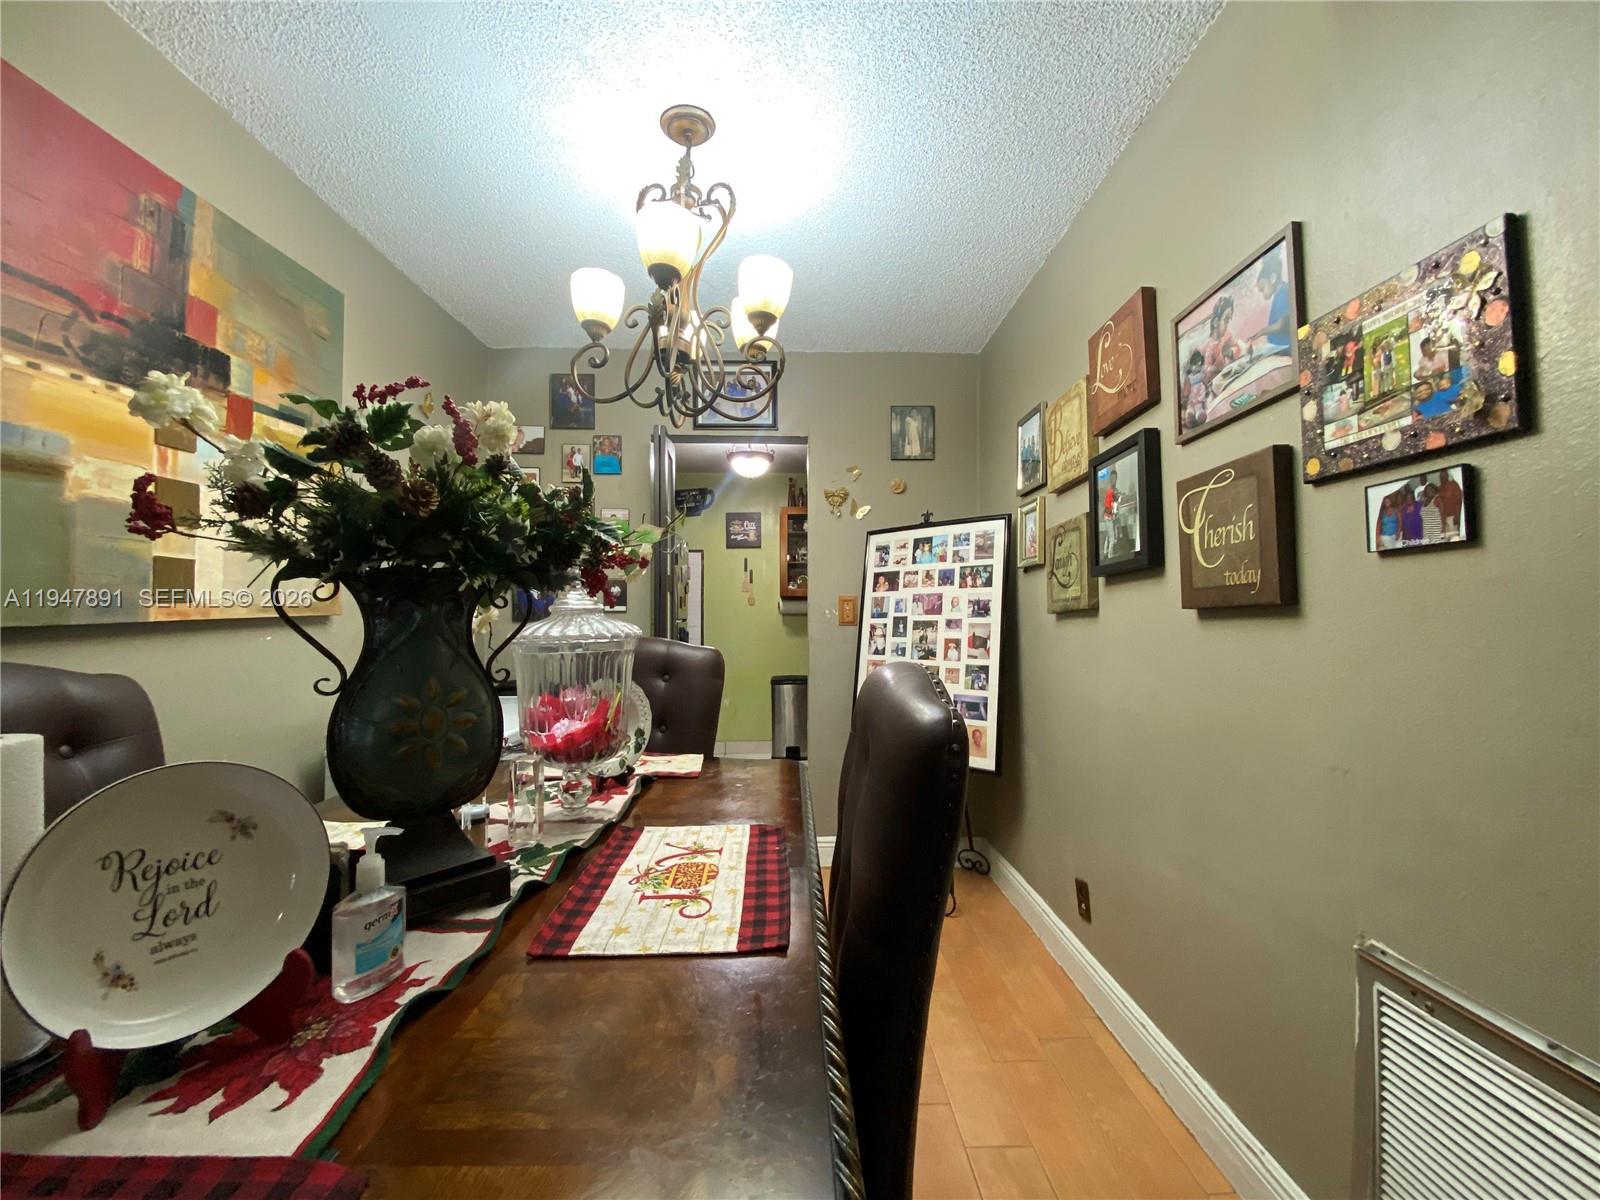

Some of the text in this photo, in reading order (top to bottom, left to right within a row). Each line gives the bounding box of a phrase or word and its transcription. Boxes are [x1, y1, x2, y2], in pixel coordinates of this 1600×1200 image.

[1179, 468, 1256, 568] Cherish
[1223, 559, 1262, 594] today
[96, 848, 224, 907] Rejoice
[166, 877, 206, 895] in the
[131, 879, 221, 941] Lord
[149, 933, 198, 955] always
